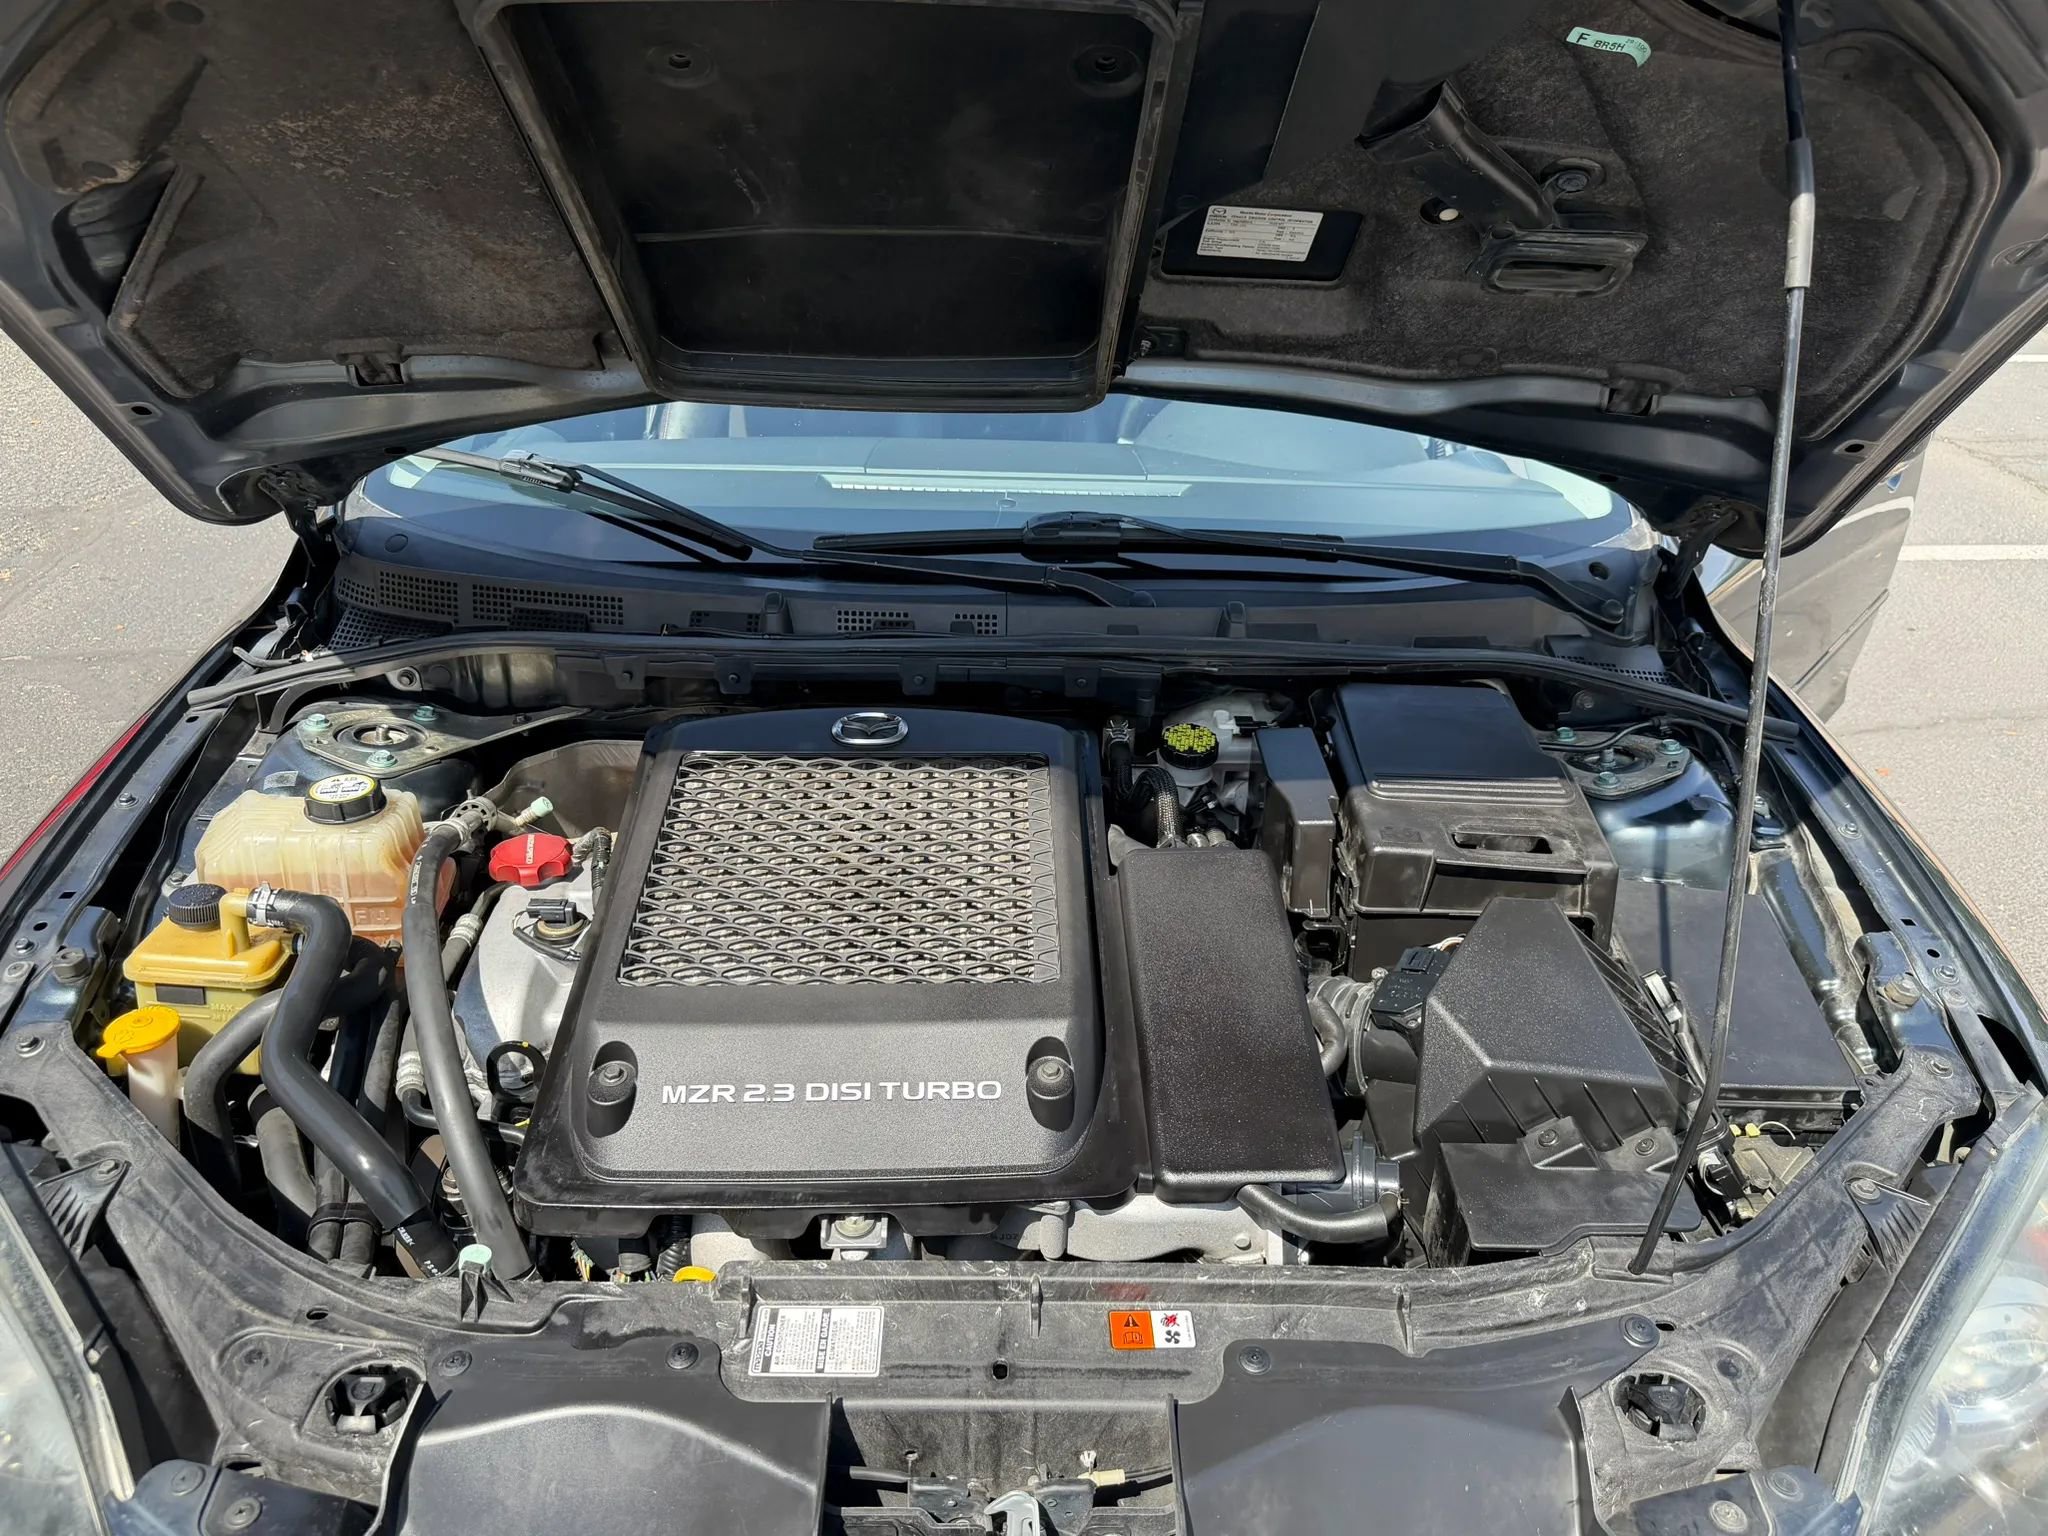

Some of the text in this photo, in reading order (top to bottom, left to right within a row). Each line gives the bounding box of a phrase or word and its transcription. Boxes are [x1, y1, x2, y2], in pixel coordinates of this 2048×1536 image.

[1576, 32, 1591, 43] F
[661, 1080, 1003, 1105] MZR 2.3 DISI TURBO
[764, 1323, 777, 1357] CAUTION
